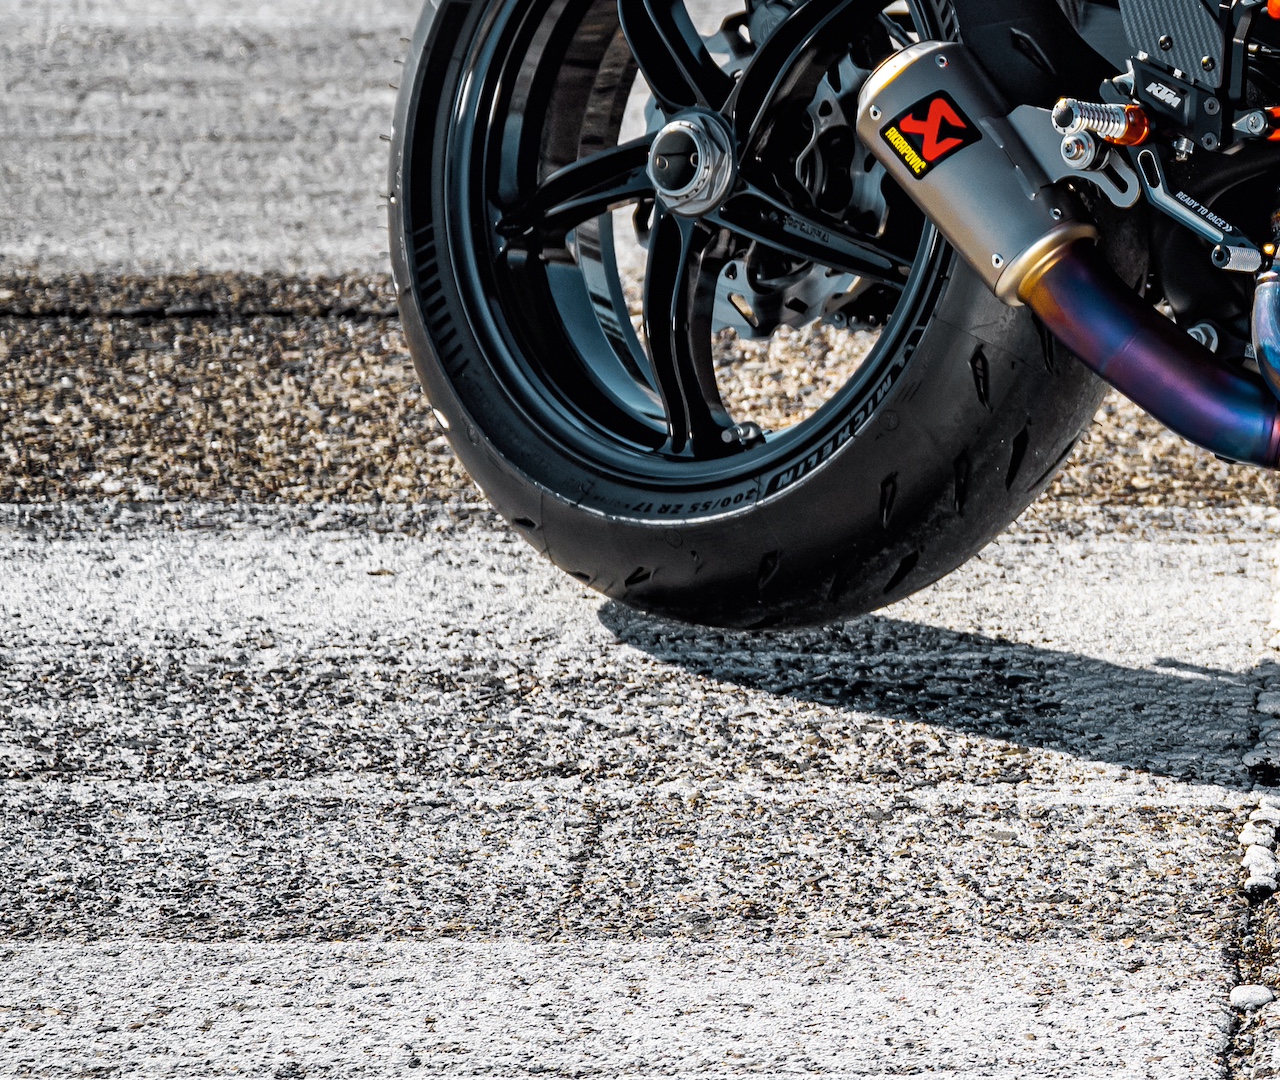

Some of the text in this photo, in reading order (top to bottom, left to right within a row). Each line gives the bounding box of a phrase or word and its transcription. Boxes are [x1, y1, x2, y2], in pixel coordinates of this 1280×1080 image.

[1145, 82, 1181, 108] KTM
[1175, 191, 1226, 227] READY TO RACE
[777, 374, 893, 490] MICHELIN
[658, 503, 683, 514] ZR
[688, 488, 758, 513] 200/55
